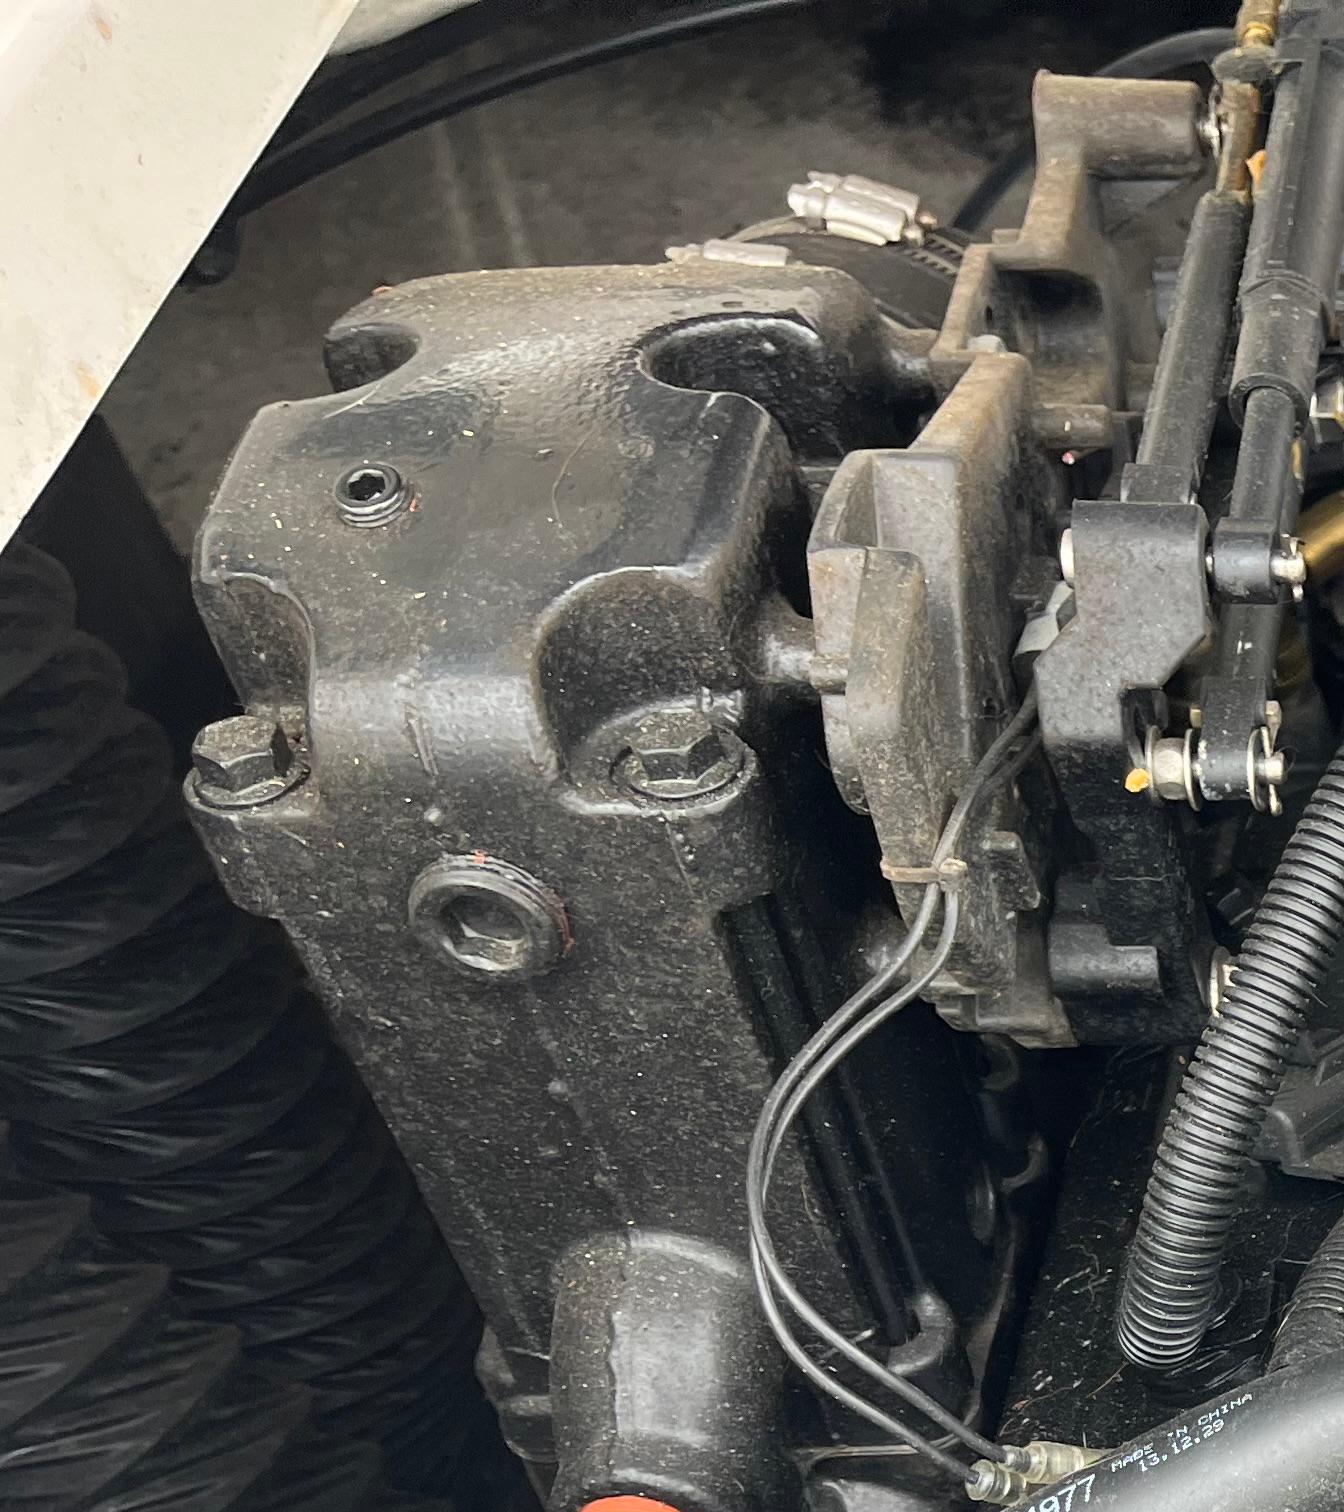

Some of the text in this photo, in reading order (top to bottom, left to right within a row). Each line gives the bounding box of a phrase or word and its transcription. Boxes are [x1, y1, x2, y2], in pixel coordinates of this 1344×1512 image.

[1111, 1442, 1154, 1473] MADE
[1167, 1424, 1188, 1440] IN
[1197, 1393, 1253, 1426] CHINA
